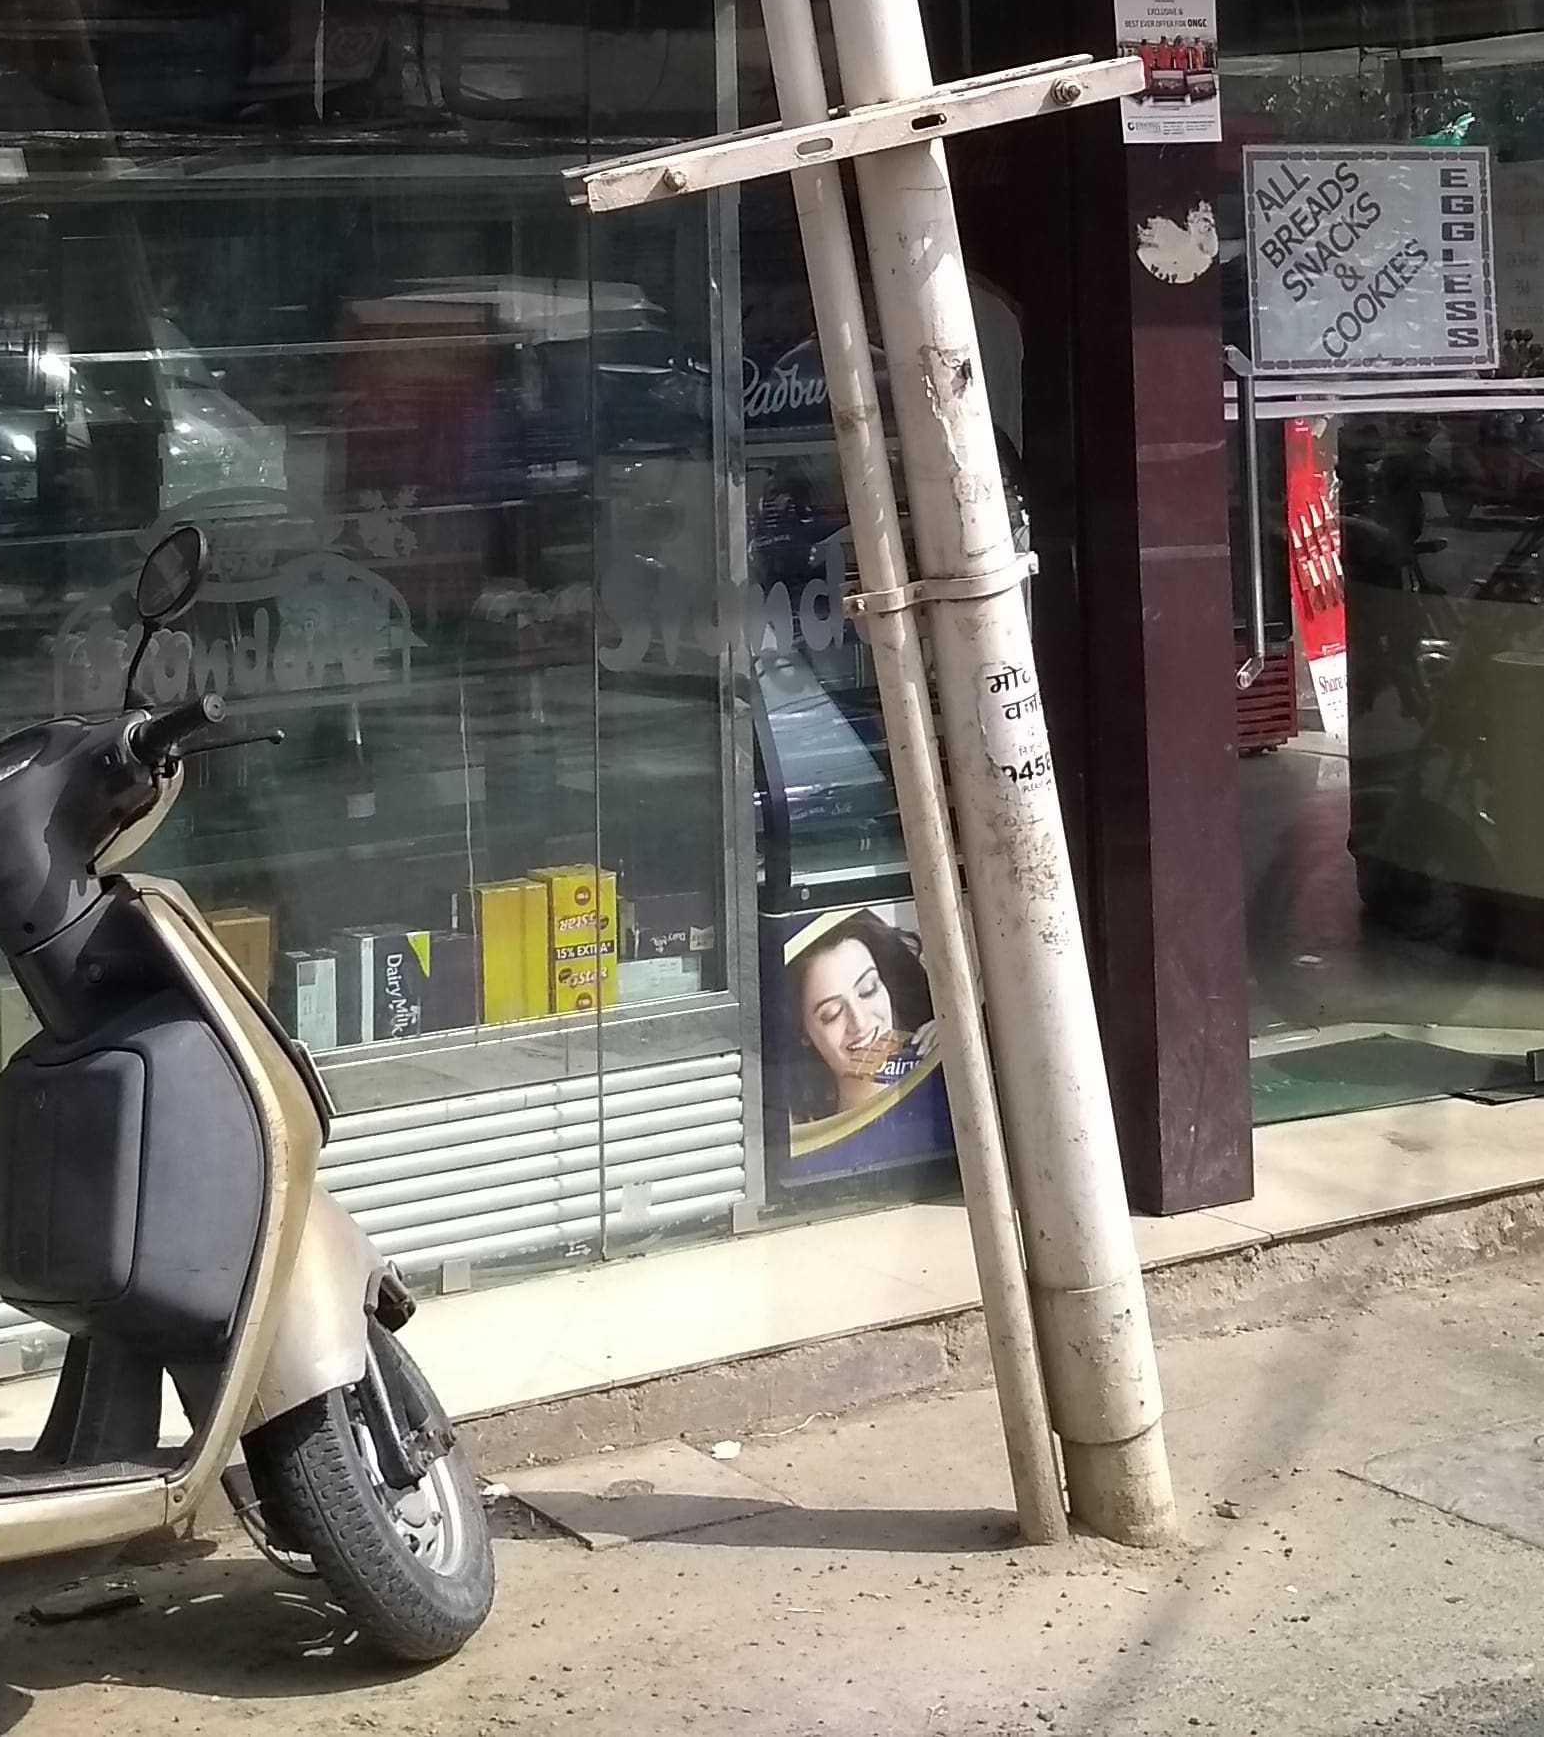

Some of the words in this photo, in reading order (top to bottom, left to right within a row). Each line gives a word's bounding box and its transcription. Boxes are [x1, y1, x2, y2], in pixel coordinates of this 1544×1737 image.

[1187, 18, 1207, 28] ONGC
[1255, 164, 1311, 224] ALL
[1260, 162, 1361, 269] BREADS
[1281, 192, 1381, 303] SNACKS
[1439, 168, 1480, 349] EGGLESS
[1322, 238, 1430, 360] COOKIES
[1336, 265, 1364, 292] &
[386, 954, 403, 998] Dairy
[556, 947, 576, 960] 15%
[391, 998, 407, 1039] Milk
